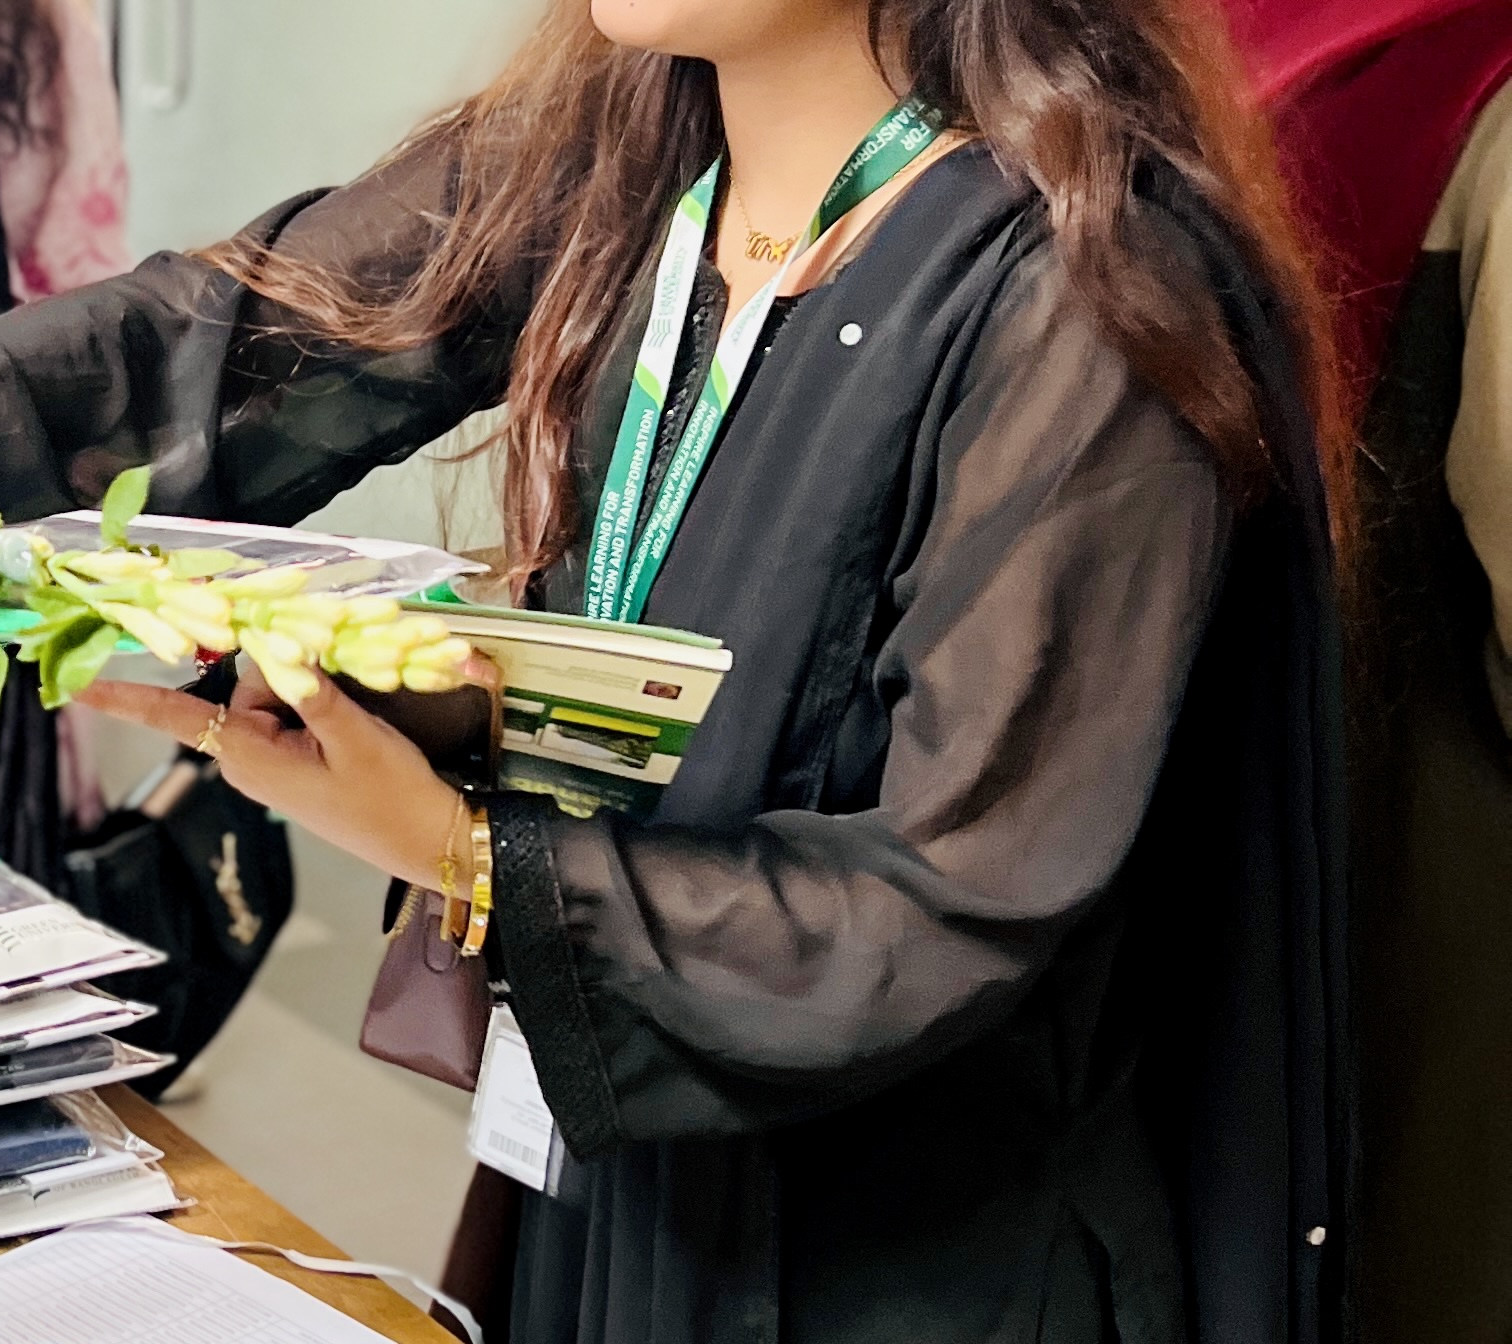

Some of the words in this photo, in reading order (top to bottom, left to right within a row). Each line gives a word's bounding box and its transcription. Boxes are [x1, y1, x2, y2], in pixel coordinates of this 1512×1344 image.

[900, 121, 931, 151] FOR
[670, 399, 709, 481] INNOVATION
[691, 406, 719, 460] INSPIRE
[614, 408, 655, 534] TRANSFORMATION
[659, 481, 676, 512] AND
[660, 459, 697, 530] LEARNING
[590, 522, 614, 591] LEARNING
[602, 491, 621, 521] FOR
[609, 536, 626, 568] AND
[650, 530, 667, 560] FOR
